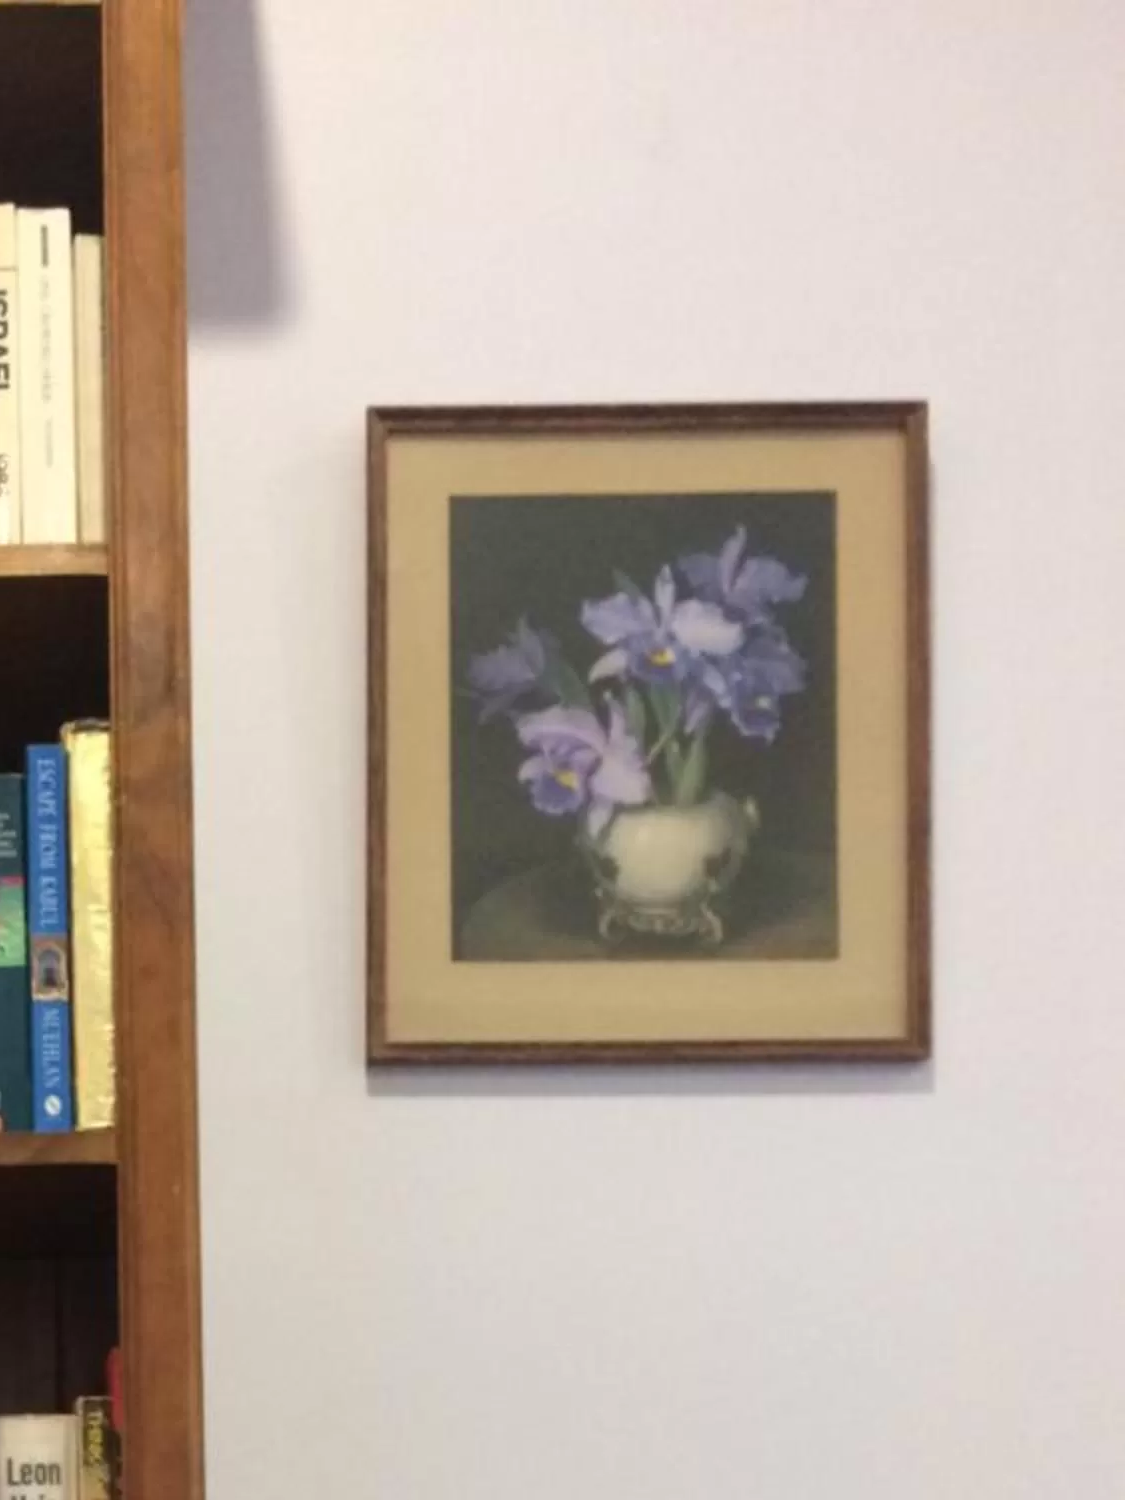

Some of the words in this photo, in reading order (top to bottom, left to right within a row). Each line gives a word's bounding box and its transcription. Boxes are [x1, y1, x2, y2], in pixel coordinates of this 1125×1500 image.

[36, 758, 59, 817] ESCAPE
[39, 823, 60, 869] FROM
[6, 1458, 61, 1488] Leon
